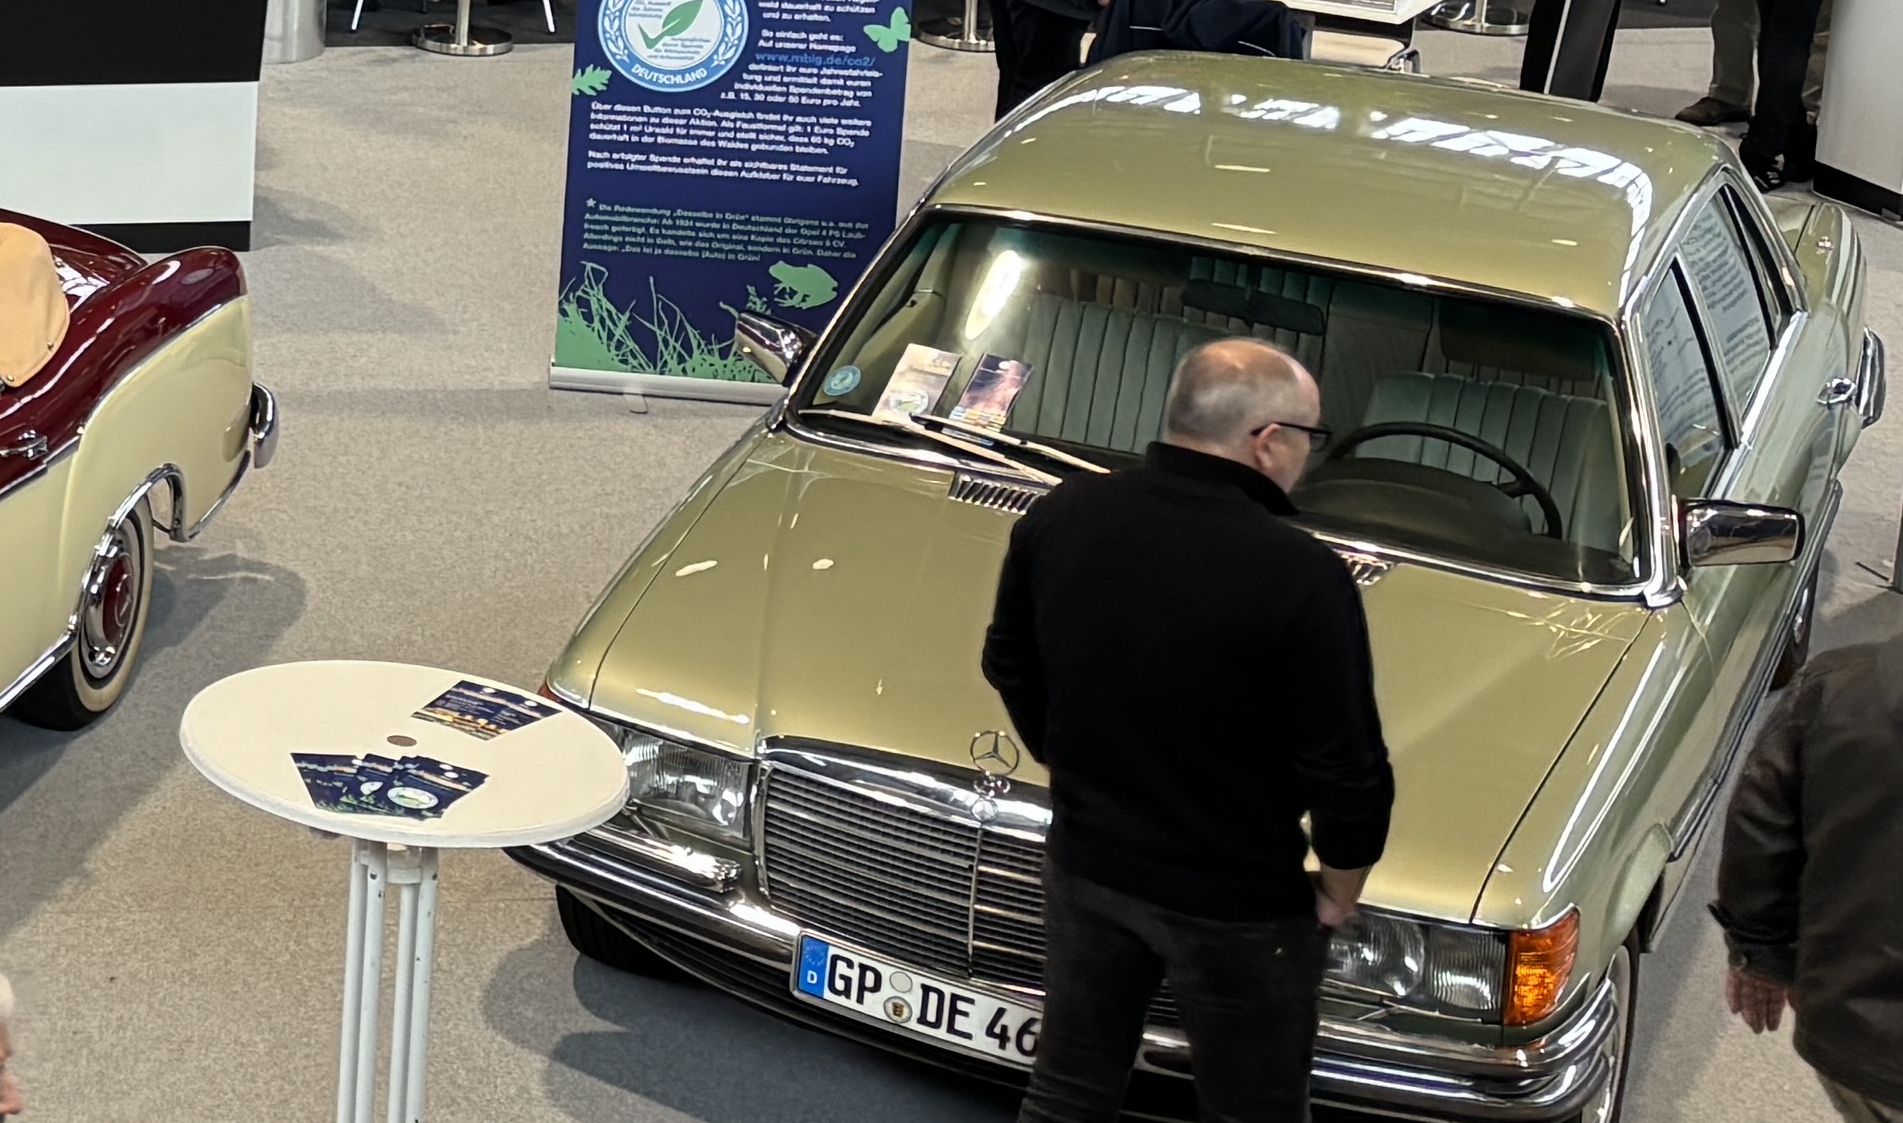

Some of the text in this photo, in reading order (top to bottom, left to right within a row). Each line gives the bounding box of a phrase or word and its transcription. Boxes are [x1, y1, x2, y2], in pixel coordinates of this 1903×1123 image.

[632, 64, 707, 84] DEUTSCHLAND
[828, 954, 882, 1005] GP
[917, 983, 976, 1040] DE
